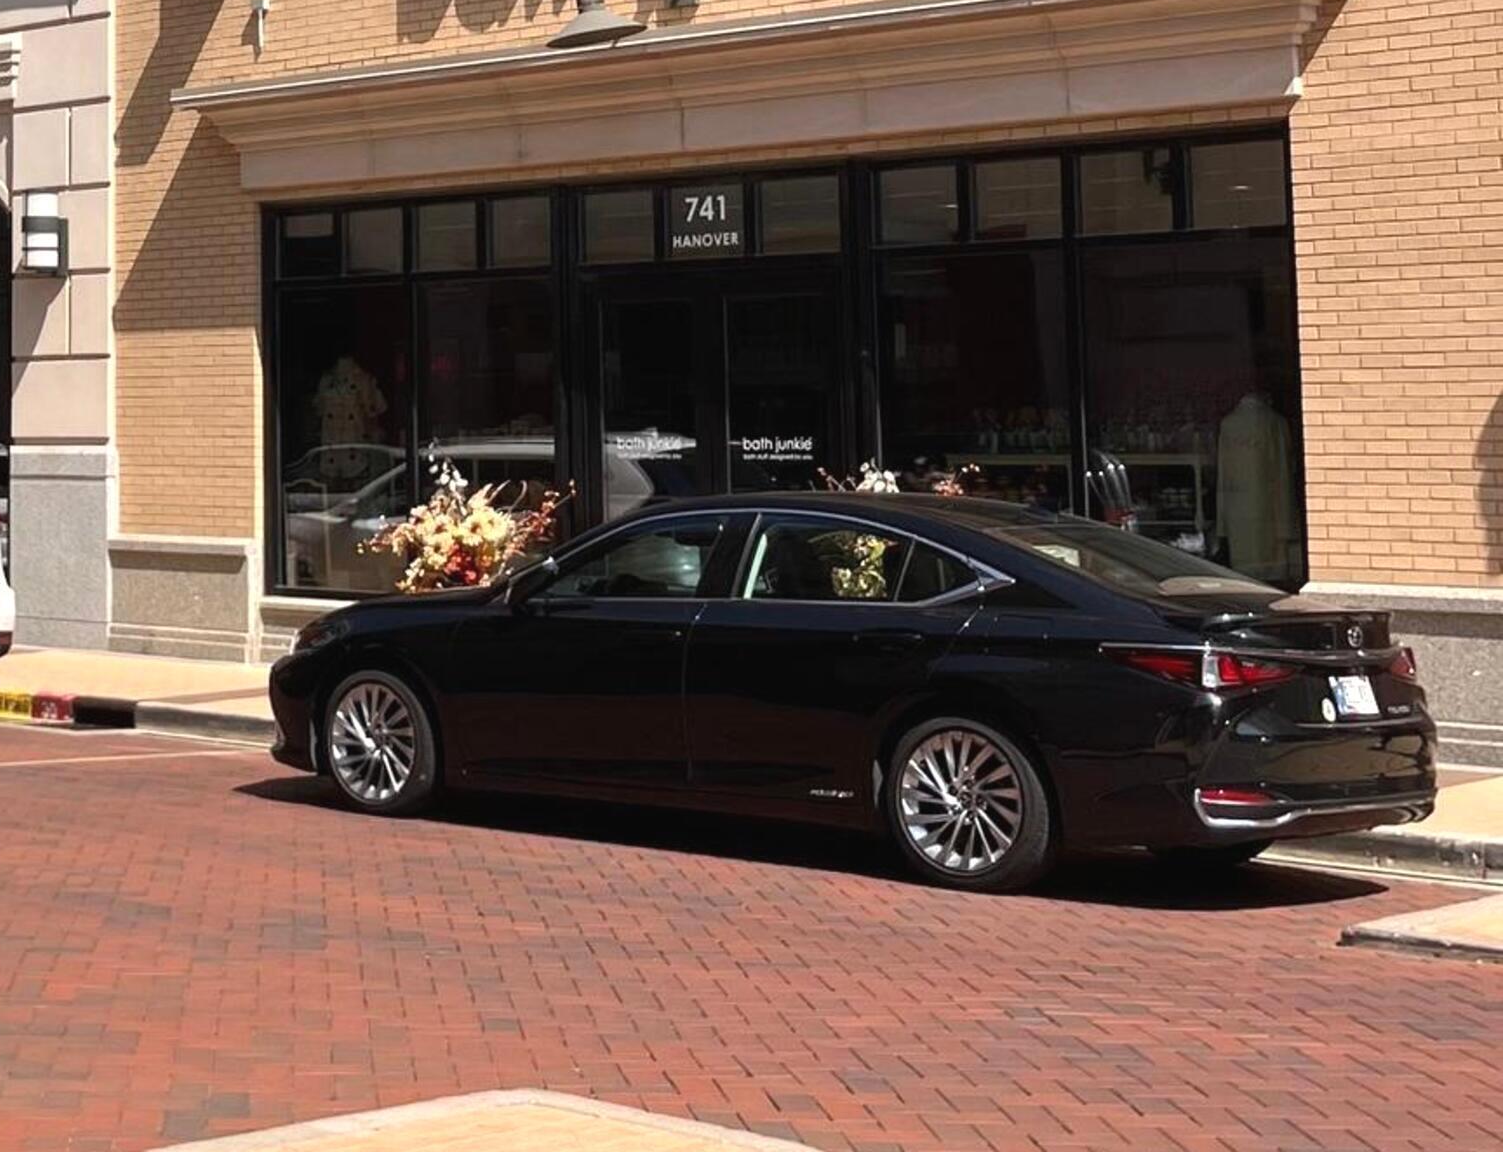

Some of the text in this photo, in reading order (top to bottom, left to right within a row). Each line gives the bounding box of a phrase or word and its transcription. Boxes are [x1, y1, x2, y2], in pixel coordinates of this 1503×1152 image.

[684, 194, 726, 223] 741
[673, 232, 739, 248] HANOVER
[616, 436, 645, 450] bath
[742, 436, 813, 453] bath junkie
